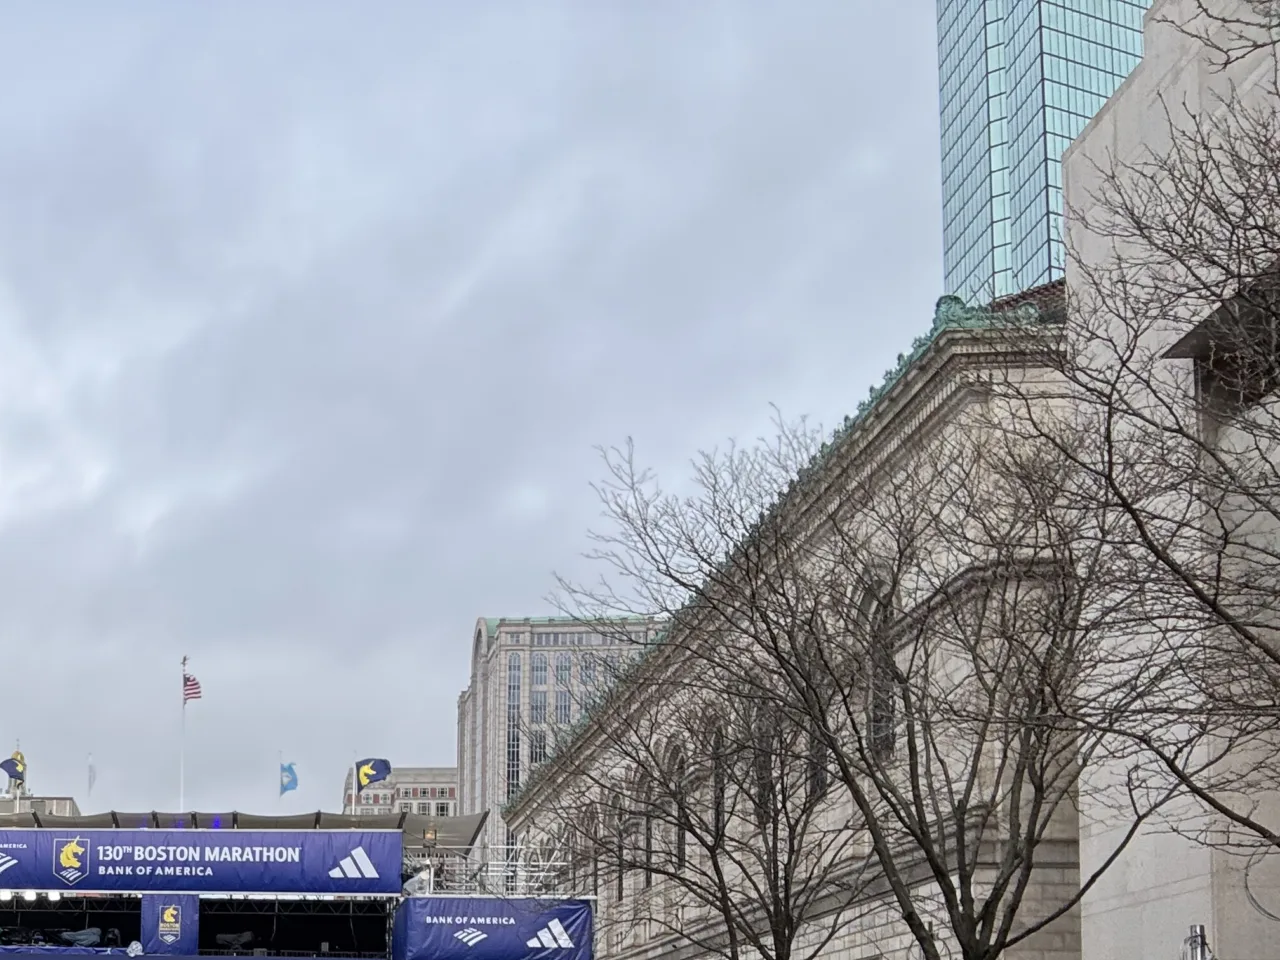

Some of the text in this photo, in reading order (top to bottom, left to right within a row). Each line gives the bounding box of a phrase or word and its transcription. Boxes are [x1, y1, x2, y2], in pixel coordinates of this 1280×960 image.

[134, 846, 200, 861] BOSTON
[204, 846, 300, 862] MARATHON
[98, 866, 213, 876] BANK OF AMERICA
[426, 916, 516, 925] BANK OF AMERICA
